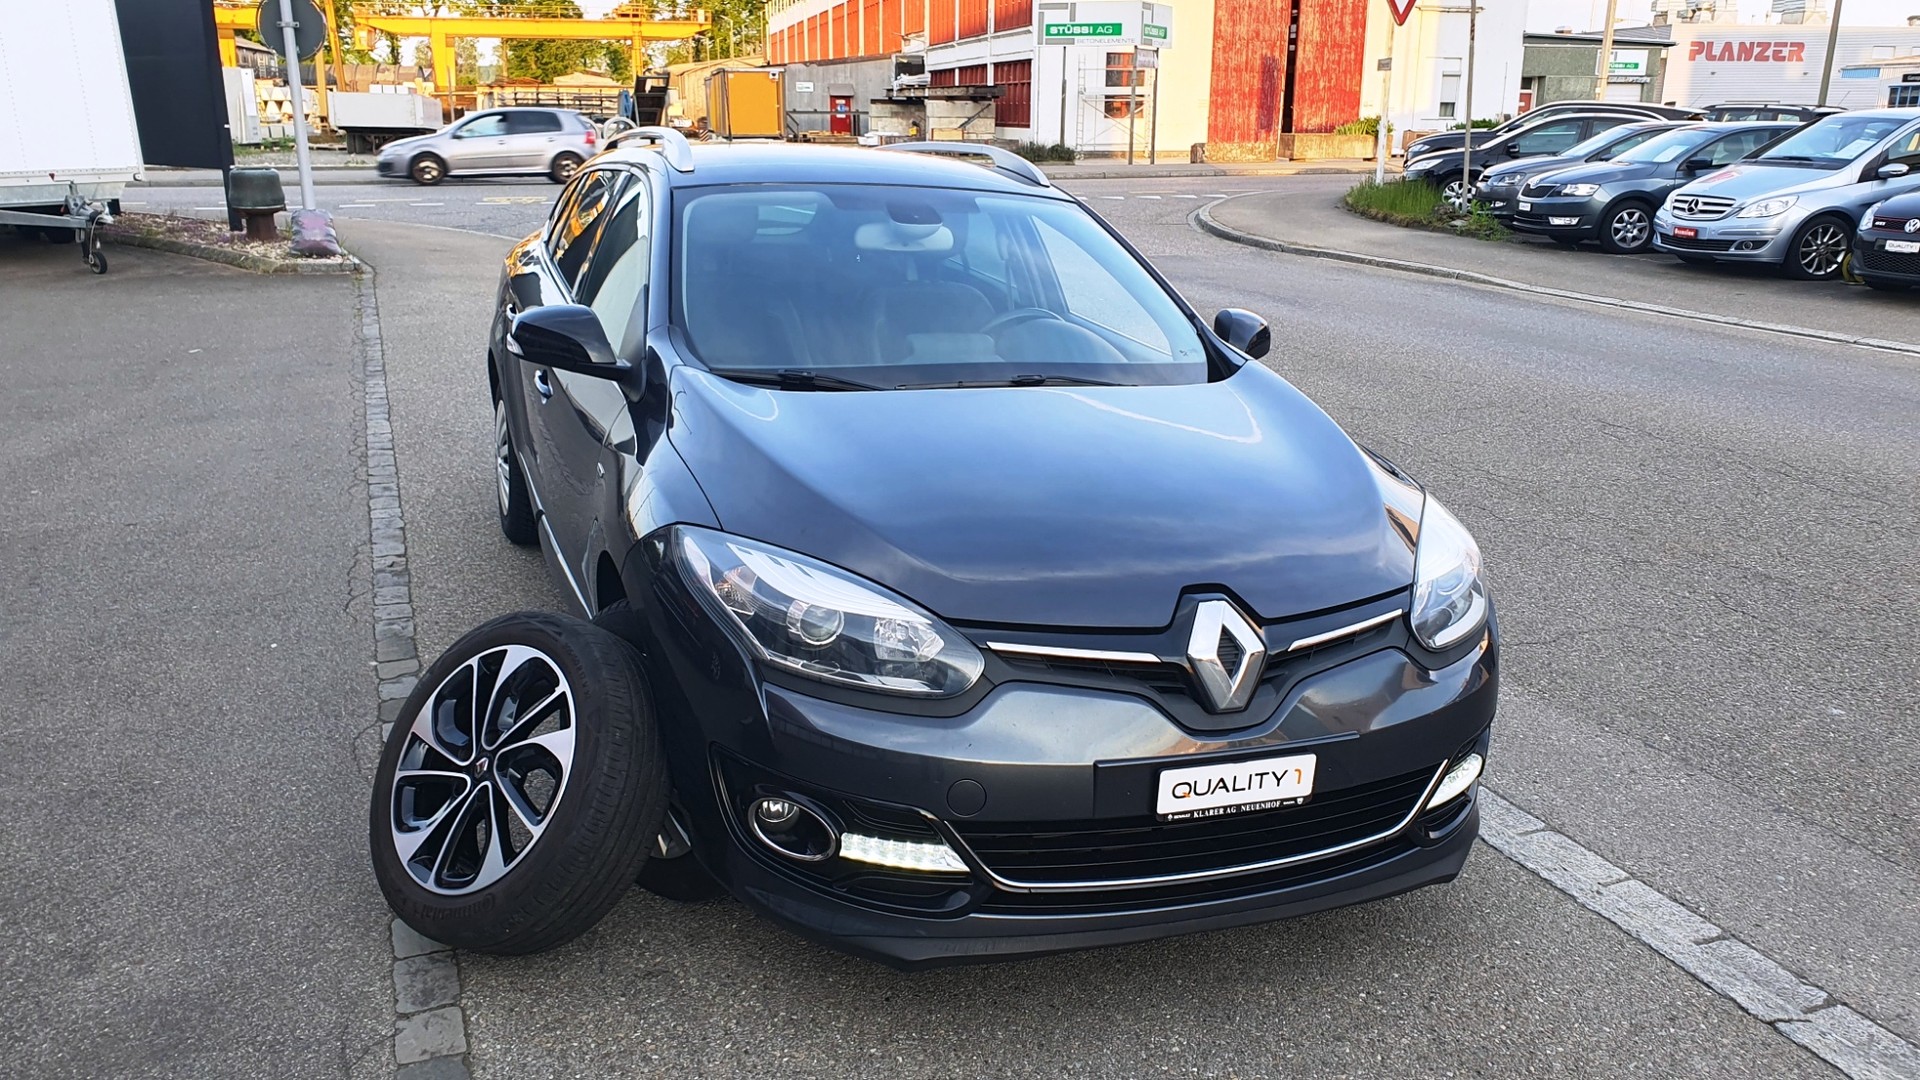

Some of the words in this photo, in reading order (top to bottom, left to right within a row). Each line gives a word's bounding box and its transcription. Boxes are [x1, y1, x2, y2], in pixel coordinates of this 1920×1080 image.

[1050, 24, 1093, 34] STÜSSI
[1096, 25, 1113, 34] AG
[1688, 41, 1805, 62] PLANZER
[1172, 770, 1288, 799] QUALITY
[1294, 768, 1302, 785] 1
[1193, 807, 1224, 818] KLARER
[1226, 805, 1237, 814] AG
[1240, 801, 1281, 812] NEUENHOF
